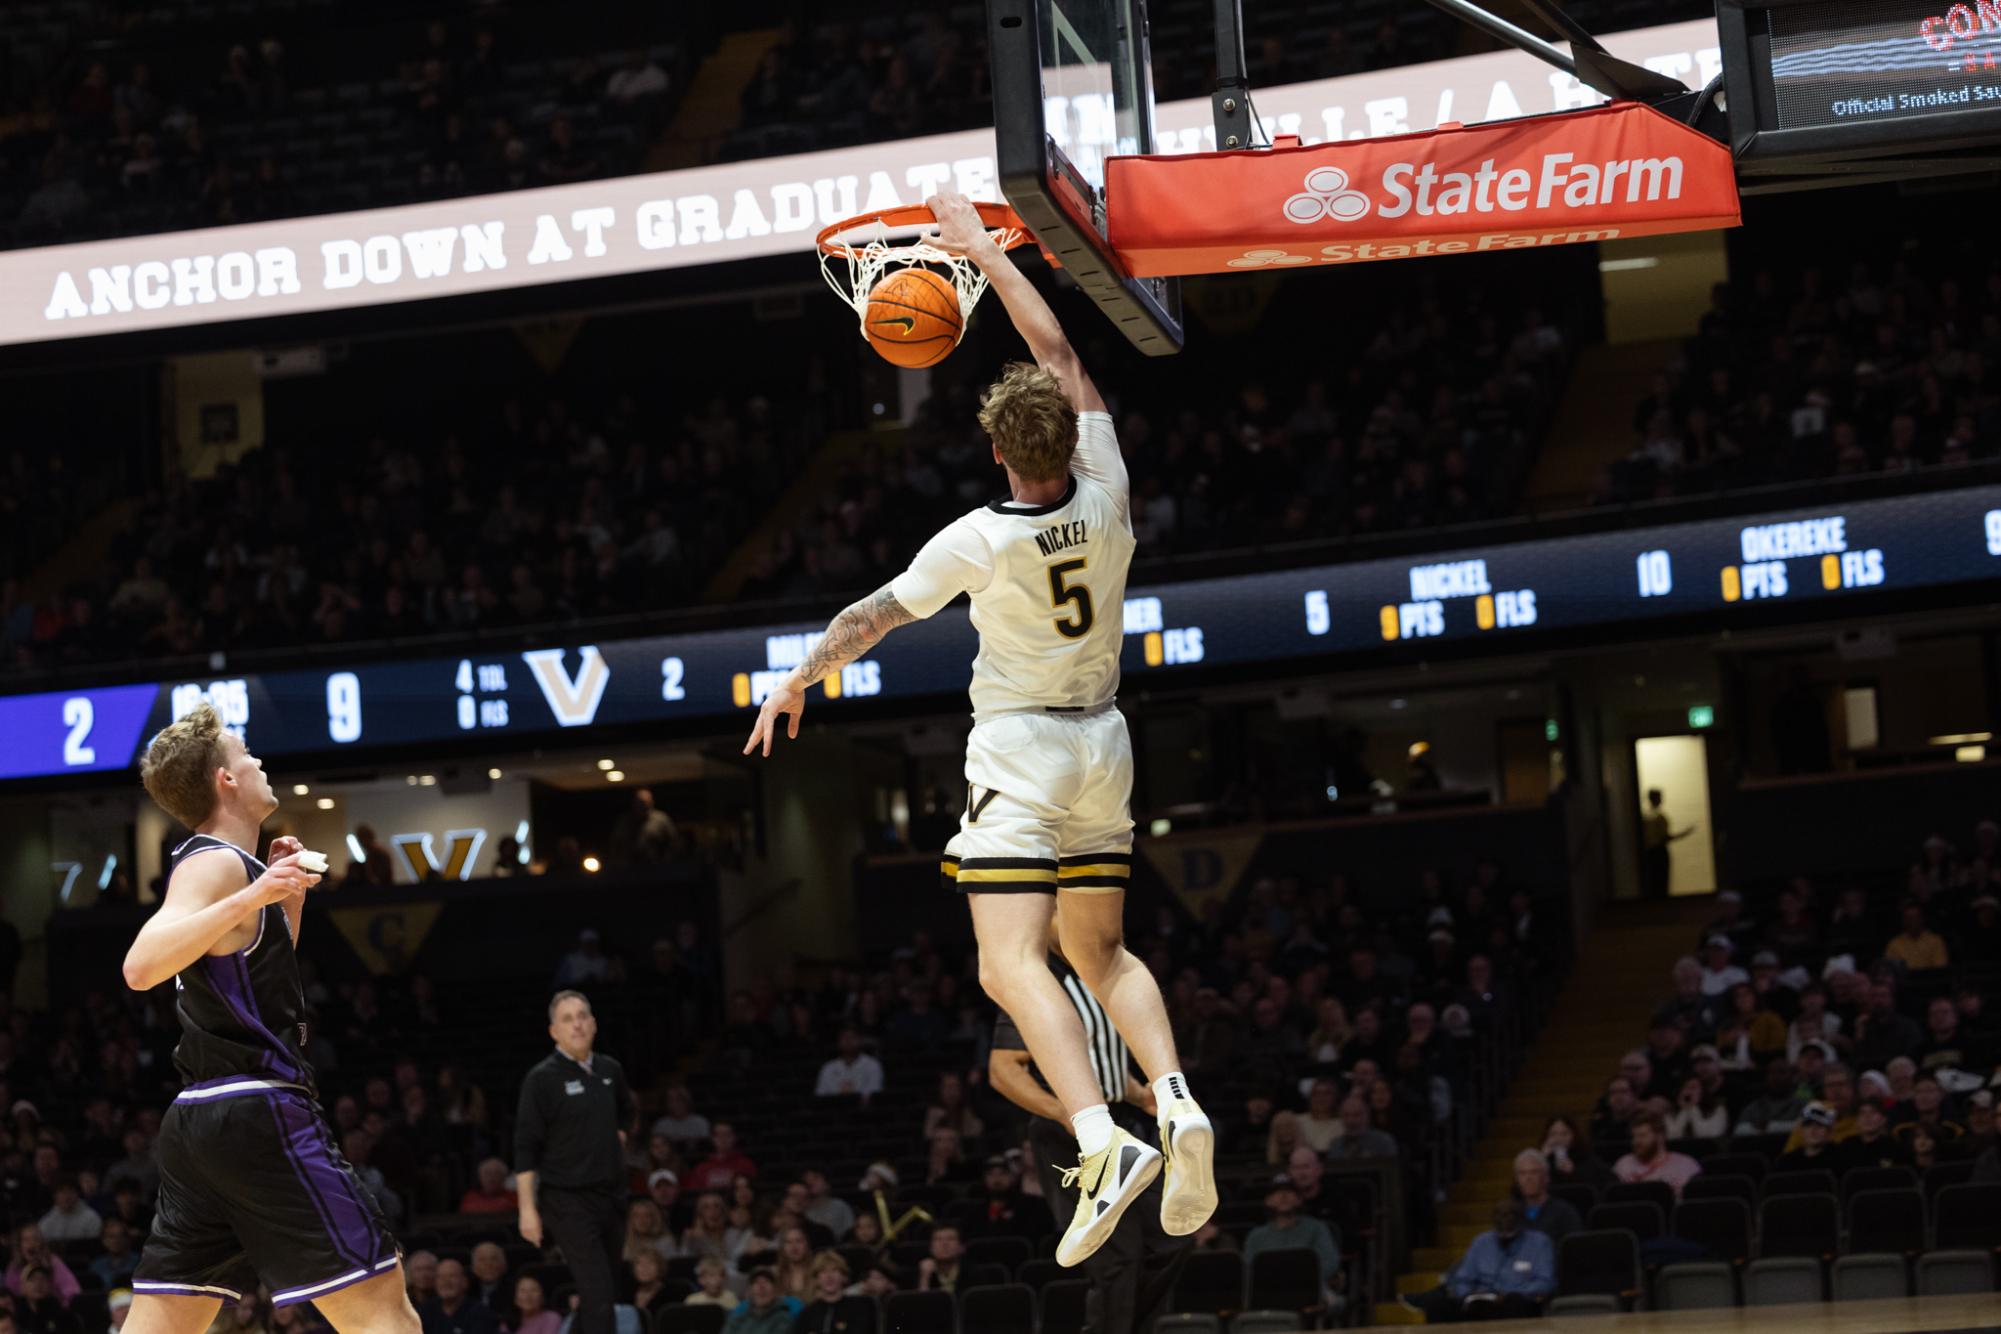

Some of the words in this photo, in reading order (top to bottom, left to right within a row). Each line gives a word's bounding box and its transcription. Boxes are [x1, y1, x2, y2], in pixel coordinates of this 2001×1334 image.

[1832, 94, 1895, 116] Official
[1900, 85, 1969, 109] Smoked
[44, 246, 301, 320] ANCHOR
[321, 220, 507, 289] DOWN
[527, 207, 615, 265] AT
[636, 157, 995, 250] GRADUATE
[1034, 519, 1088, 557] NICKEL
[1741, 516, 1848, 563] OKEREKE
[1409, 559, 1492, 602] NICKEL
[1637, 549, 1673, 598] 10
[1721, 565, 1741, 602] 0
[1741, 561, 1788, 600] PTS
[1821, 553, 1841, 590] 0
[1842, 549, 1885, 588] FLS
[1047, 556, 1095, 641] 5
[1304, 590, 1330, 635] 5
[1399, 600, 1445, 640] PTS
[1495, 589, 1537, 628] FLS
[1163, 627, 1204, 665] FLS
[455, 659, 475, 693] 4
[661, 657, 685, 701] 2
[326, 672, 362, 743] 9
[63, 697, 95, 766] 2
